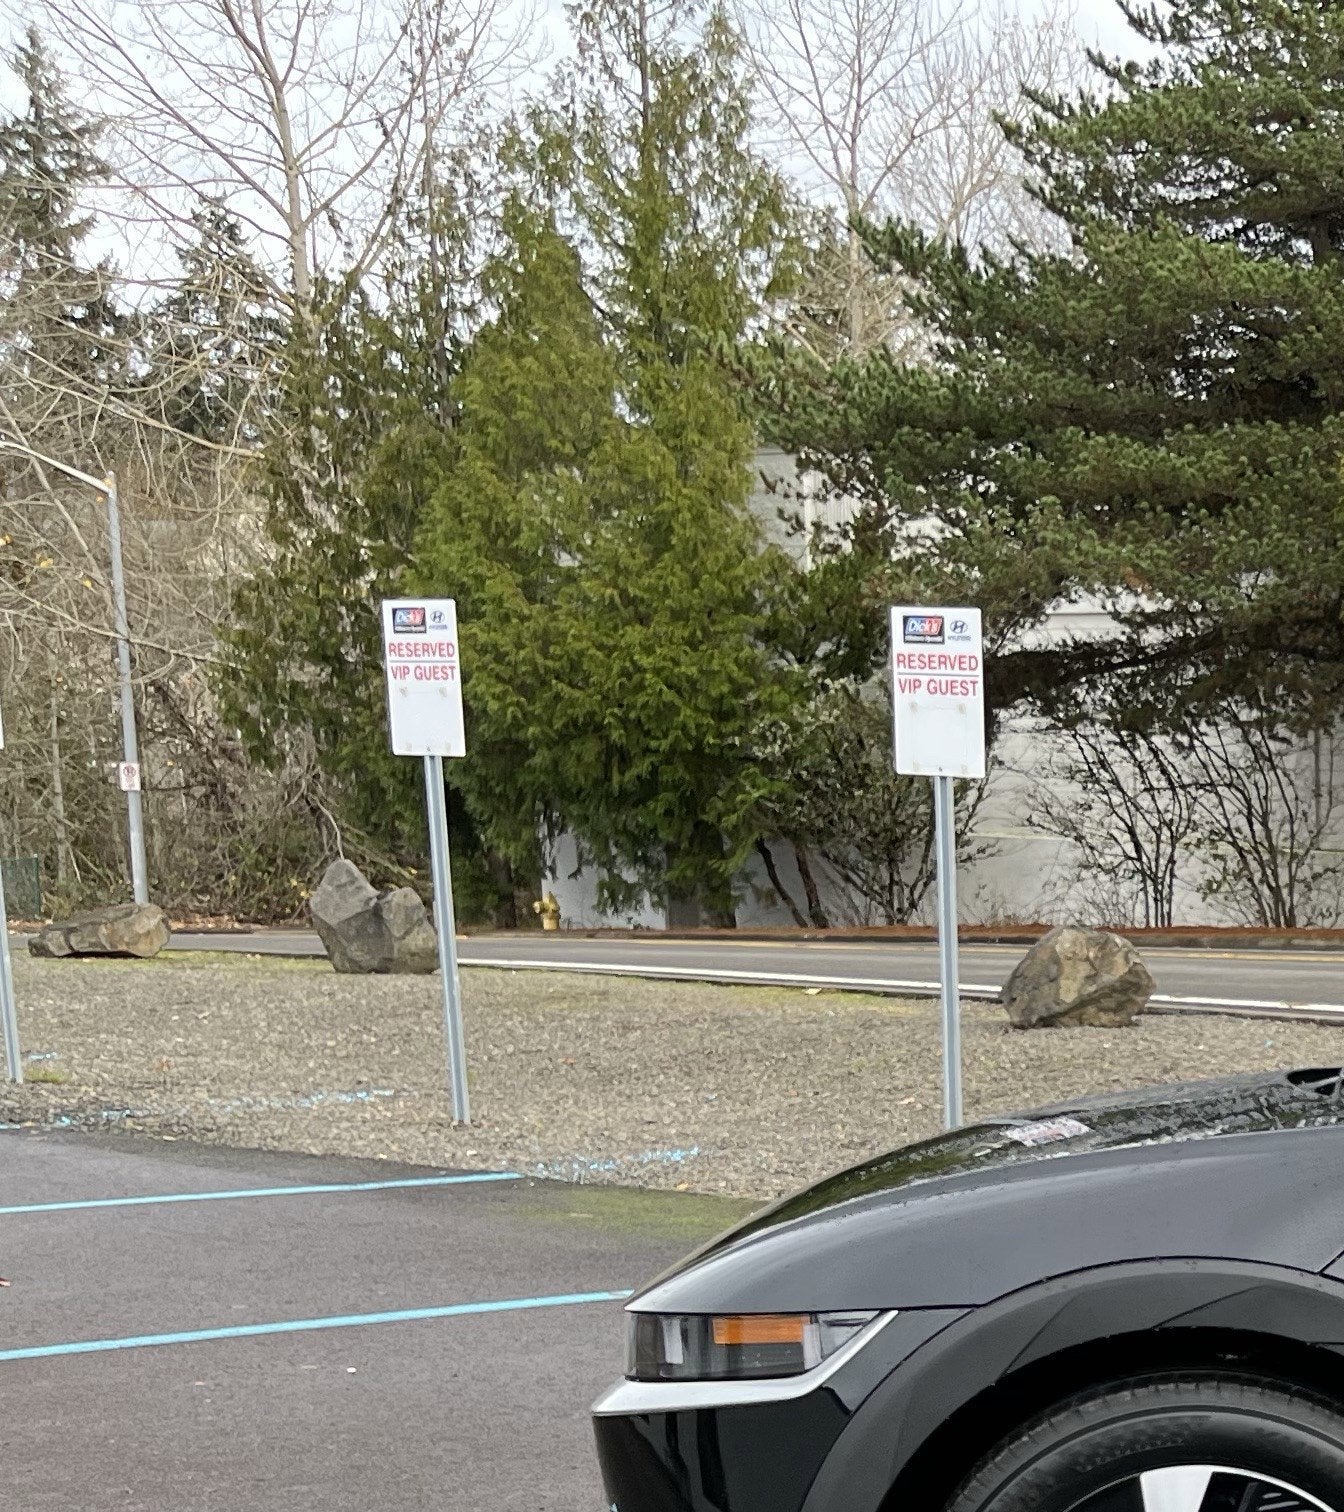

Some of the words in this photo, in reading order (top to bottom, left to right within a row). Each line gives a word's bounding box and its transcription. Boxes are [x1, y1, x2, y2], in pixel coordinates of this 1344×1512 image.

[388, 642, 455, 658] RESERVED
[896, 653, 979, 672] RESERVED
[390, 665, 410, 680] VIP
[413, 665, 456, 681] GUEST
[898, 677, 922, 694] VIP
[926, 678, 979, 697] GUEST
